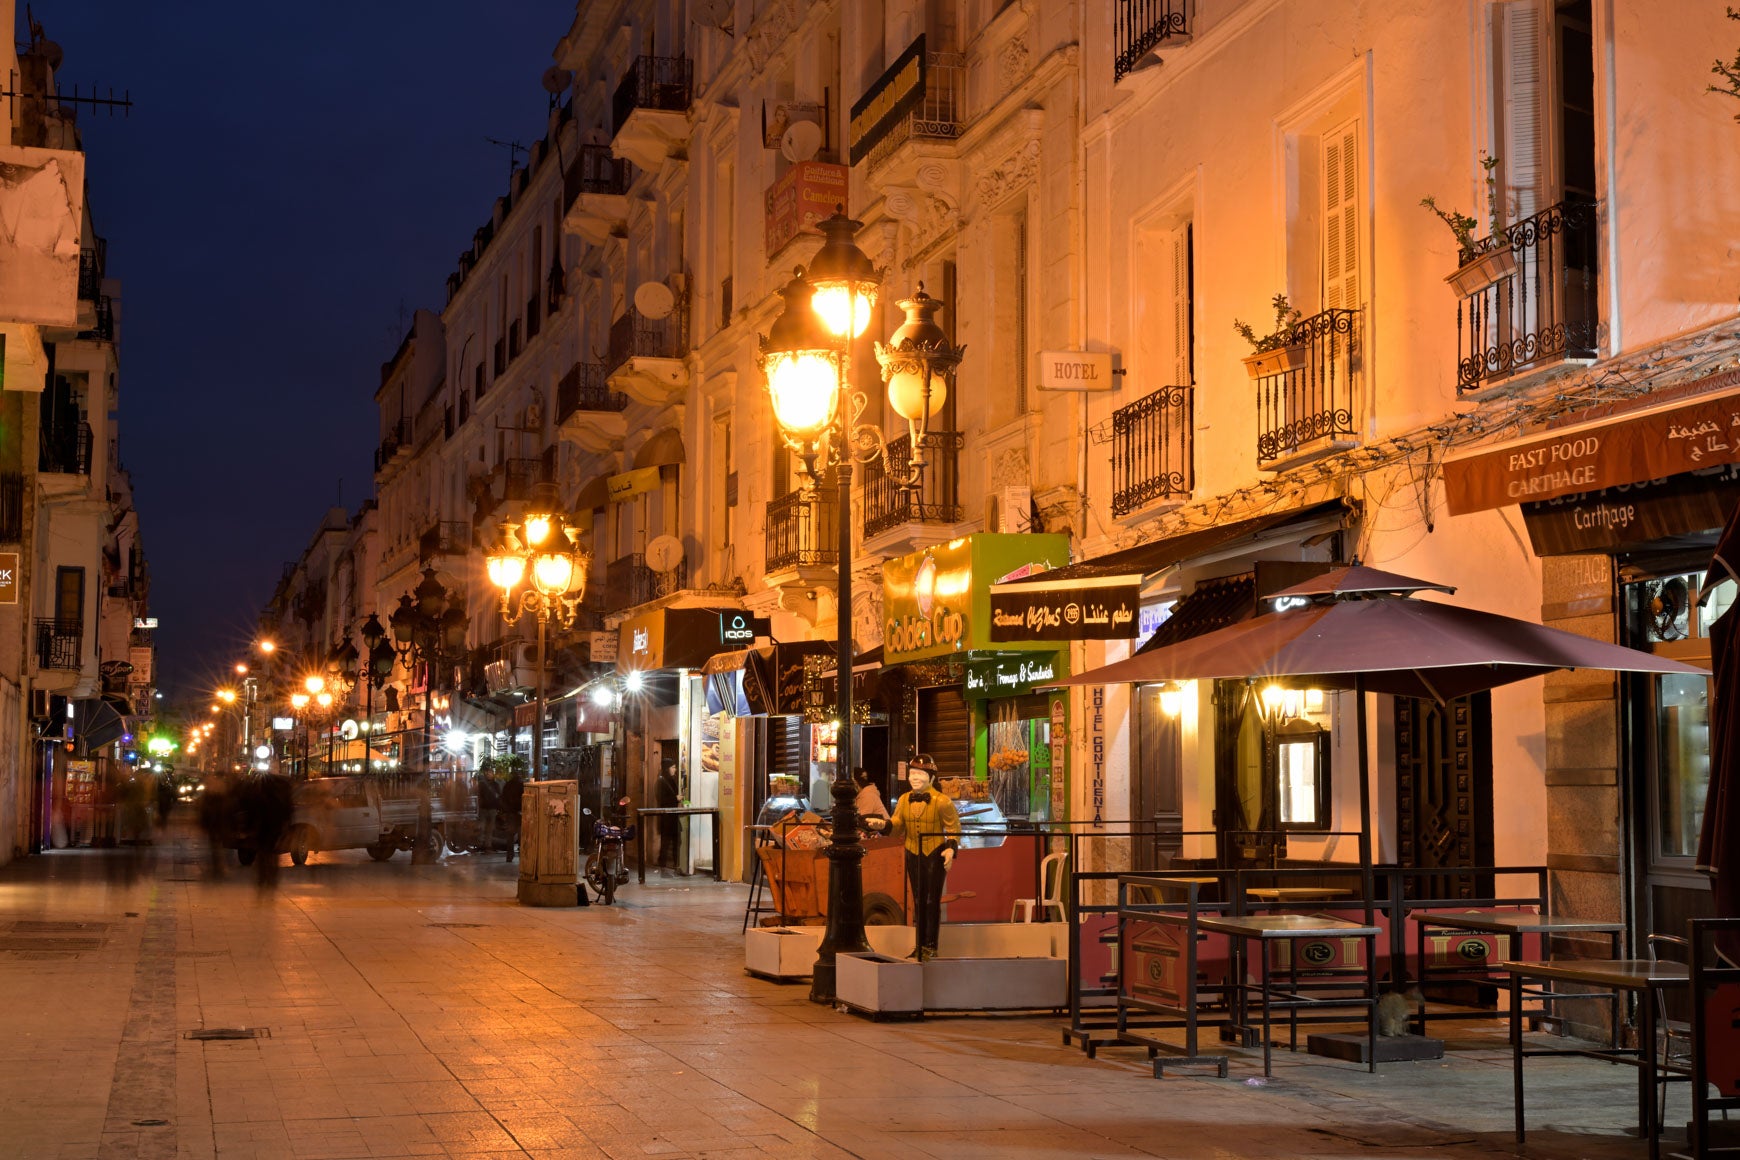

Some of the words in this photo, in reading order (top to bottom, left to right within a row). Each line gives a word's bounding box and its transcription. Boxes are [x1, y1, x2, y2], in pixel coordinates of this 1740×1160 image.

[1054, 362, 1099, 380] HOTEL
[1508, 448, 1546, 472] FAST
[1551, 437, 1599, 462] FOOD
[1507, 465, 1596, 498] CARTHAGE
[1574, 504, 1635, 530] Carthage
[725, 630, 753, 639] IQOS
[885, 617, 931, 653] Golden
[934, 606, 962, 652] Cup
[1020, 663, 1026, 683] &
[1093, 688, 1103, 732] HOTEL
[1093, 736, 1103, 828] CONTINENTAL
